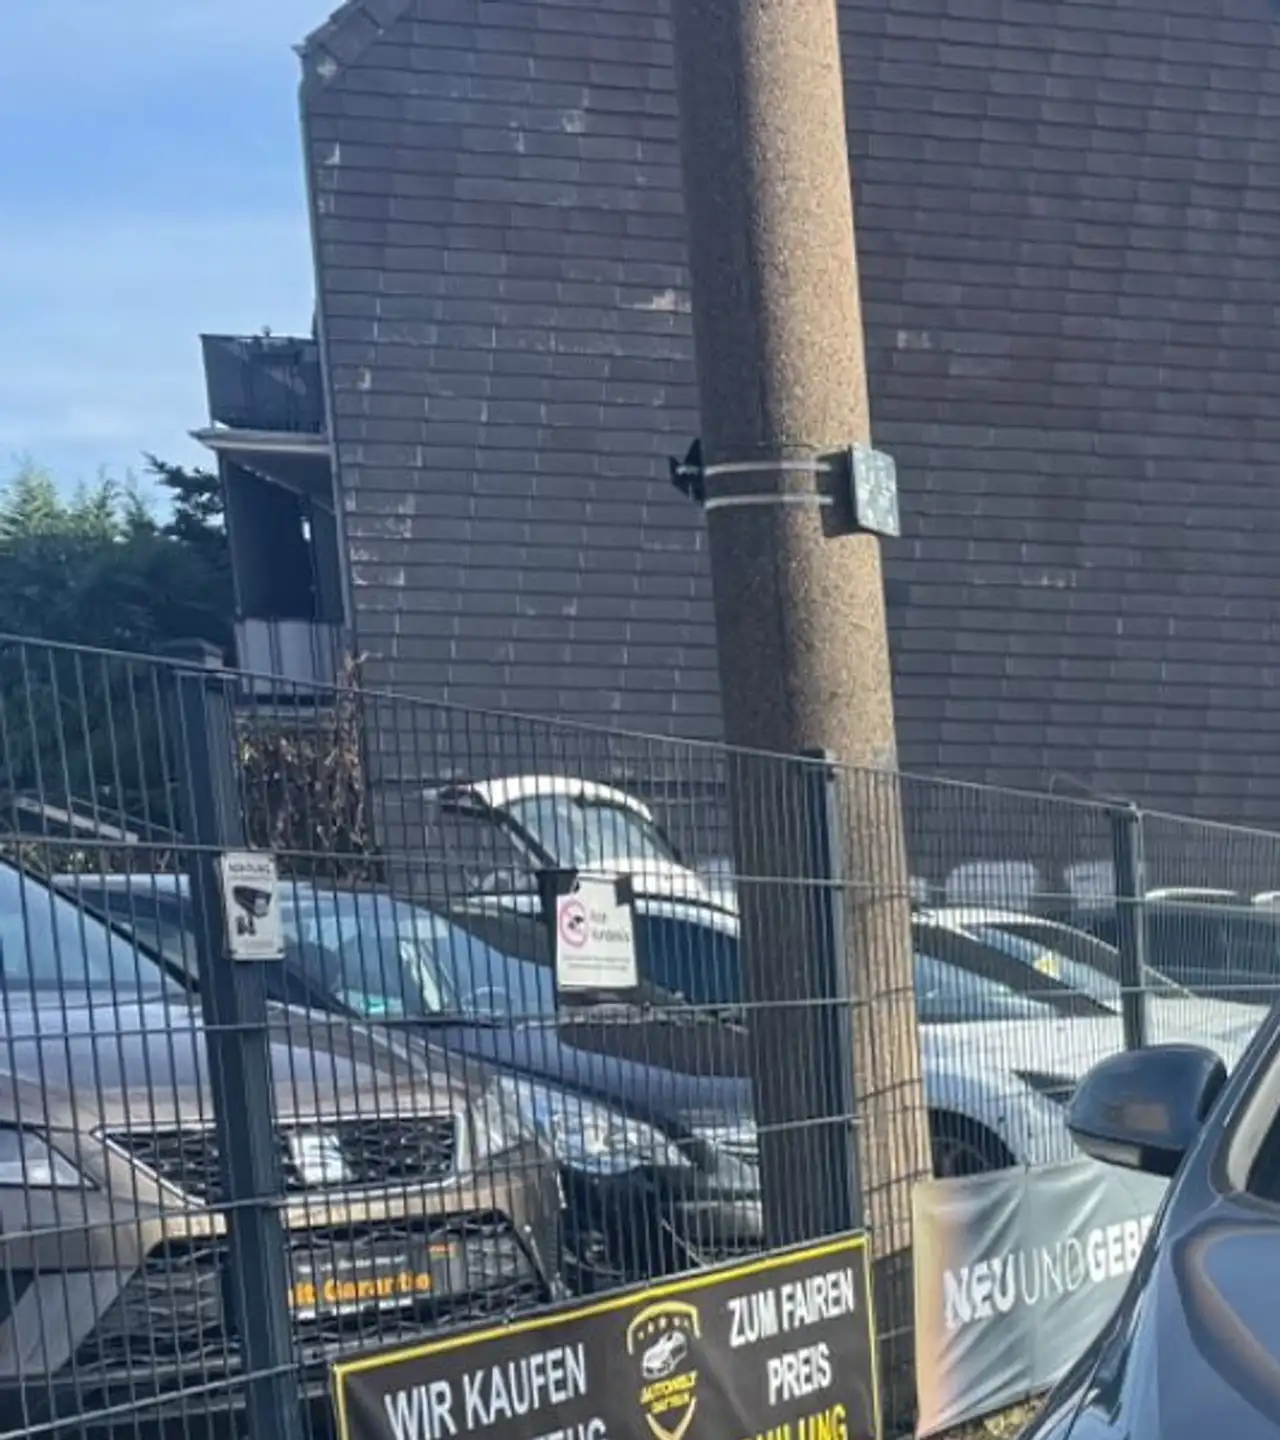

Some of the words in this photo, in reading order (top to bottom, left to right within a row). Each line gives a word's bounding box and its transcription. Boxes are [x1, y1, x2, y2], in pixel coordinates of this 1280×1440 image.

[727, 1287, 779, 1348] ZUM
[781, 1267, 855, 1332] FAIREN
[944, 1253, 1016, 1330] NEU
[1020, 1236, 1085, 1305] UND
[462, 1342, 587, 1431] KAUFEN
[767, 1341, 832, 1406] PREIS
